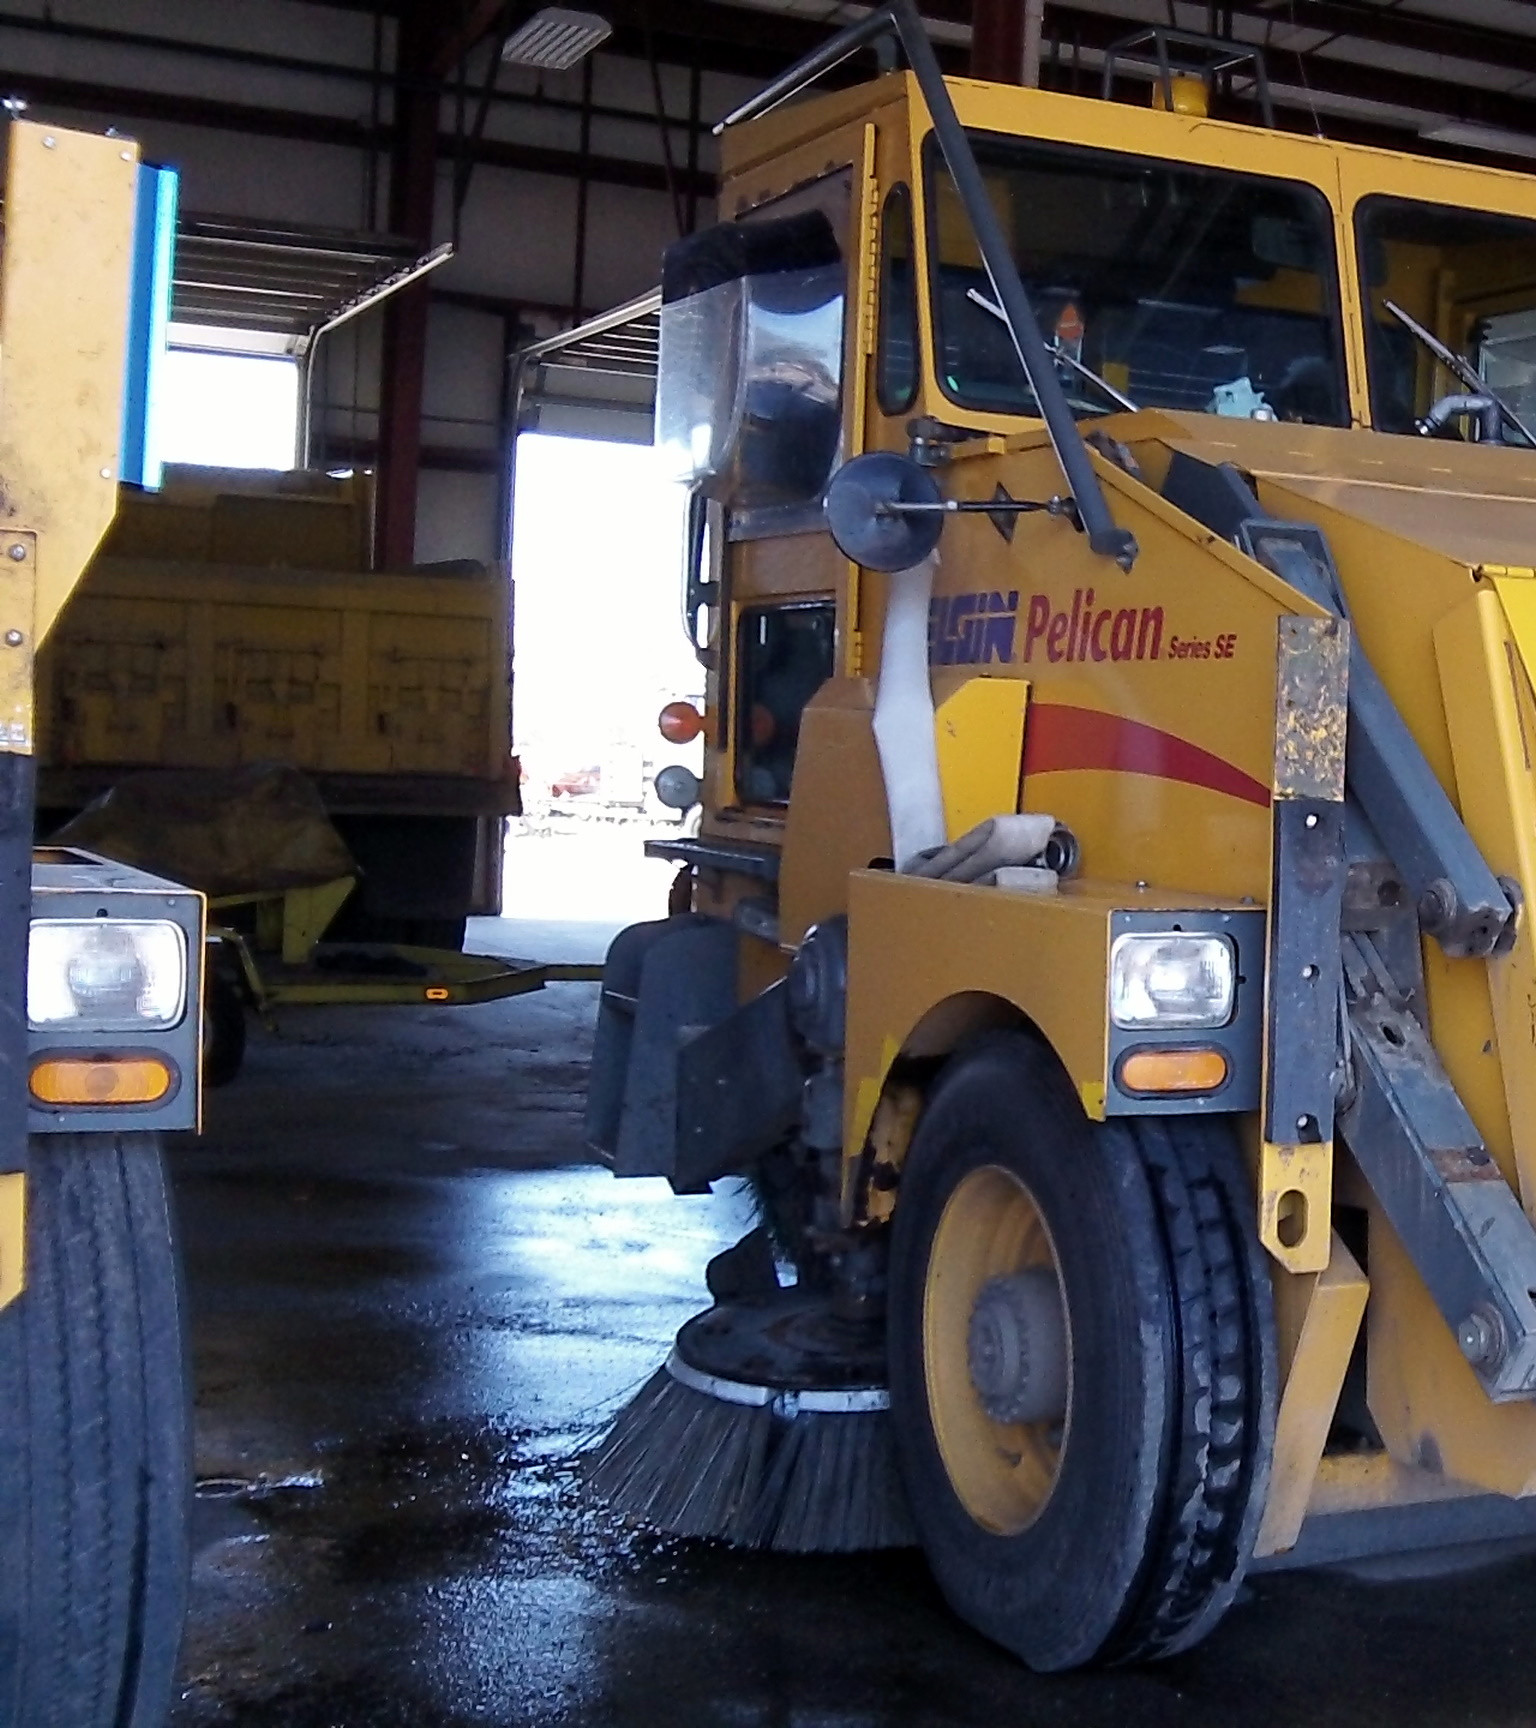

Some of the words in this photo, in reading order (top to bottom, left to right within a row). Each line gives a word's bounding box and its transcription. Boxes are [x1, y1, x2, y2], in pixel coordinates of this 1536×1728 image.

[1024, 587, 1164, 663] Pelican
[1168, 635, 1211, 659] Series
[1214, 634, 1237, 659] SE
